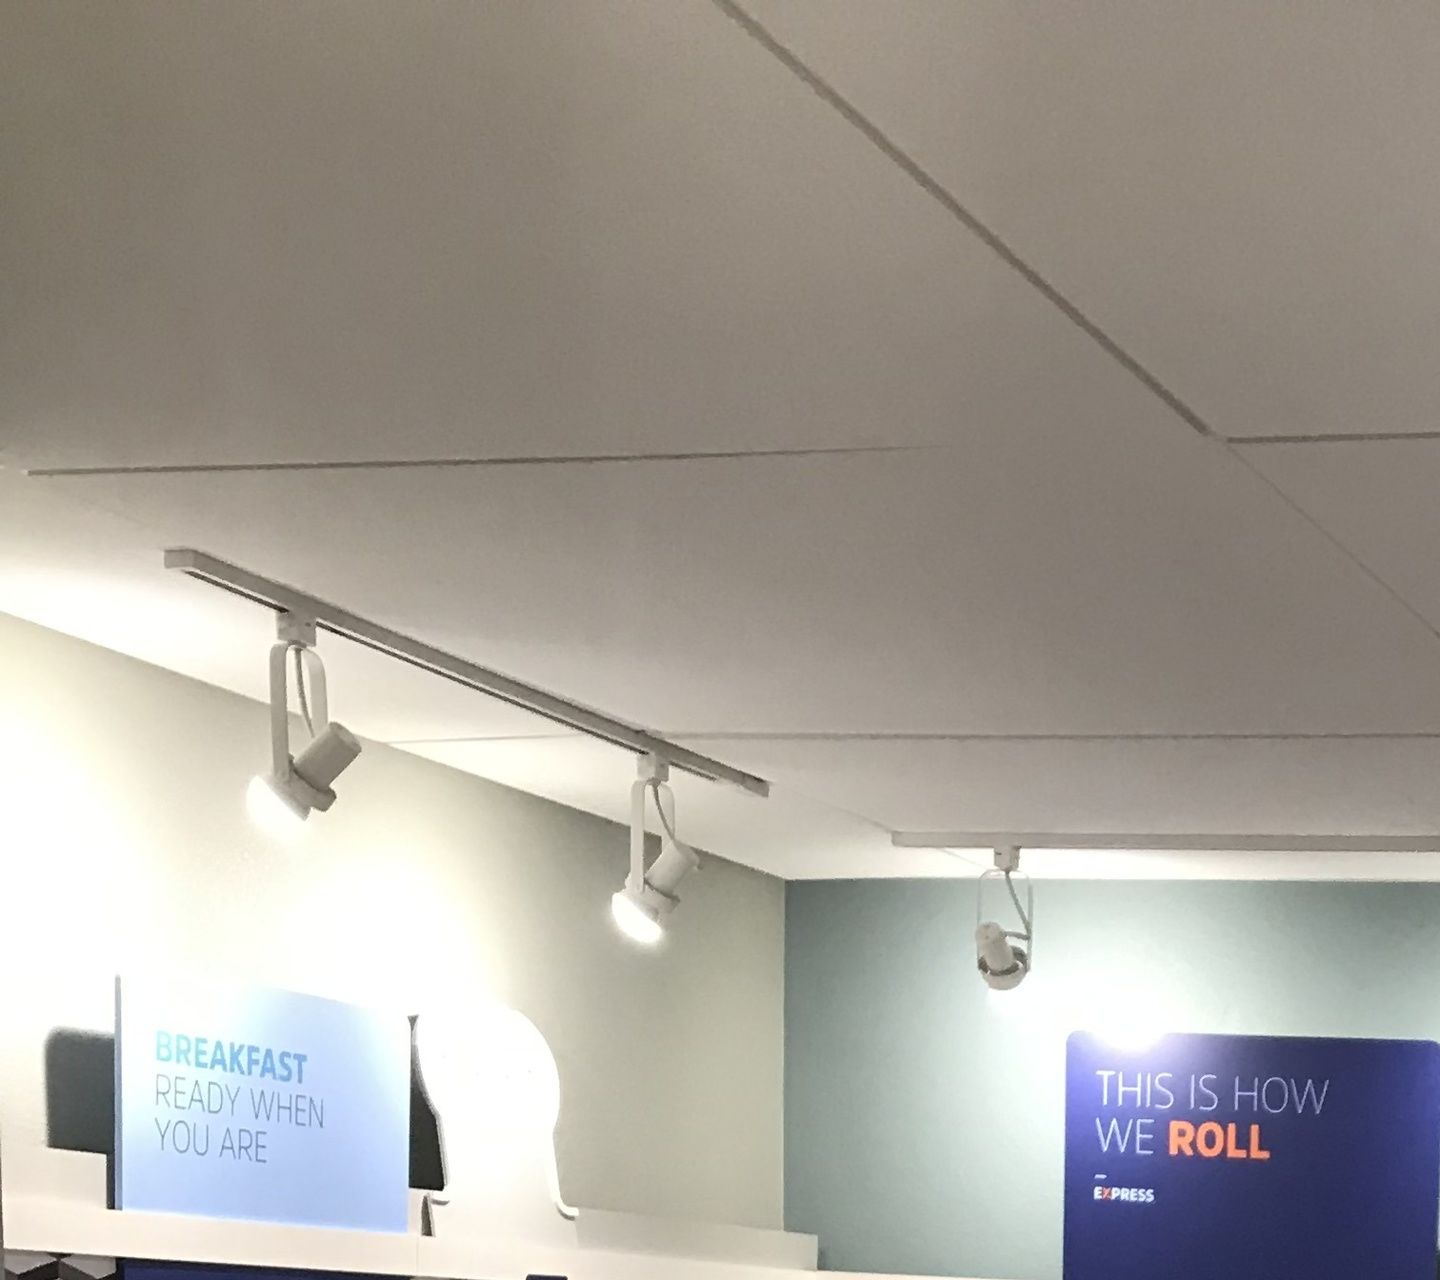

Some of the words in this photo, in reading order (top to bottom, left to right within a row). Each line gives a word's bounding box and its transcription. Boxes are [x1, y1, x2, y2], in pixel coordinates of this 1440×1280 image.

[156, 1030, 308, 1084] BREAKFAST
[155, 1073, 241, 1116] READY
[250, 1087, 324, 1128] WHEN
[1096, 1070, 1174, 1109] THIS
[1190, 1074, 1219, 1110] IS
[1234, 1076, 1330, 1115] HOW
[154, 1117, 209, 1156] YOU
[219, 1127, 268, 1163] ARE
[1095, 1117, 1155, 1154] WE
[1168, 1120, 1271, 1159] ROLL
[1093, 1187, 1155, 1203] EXPRESS
